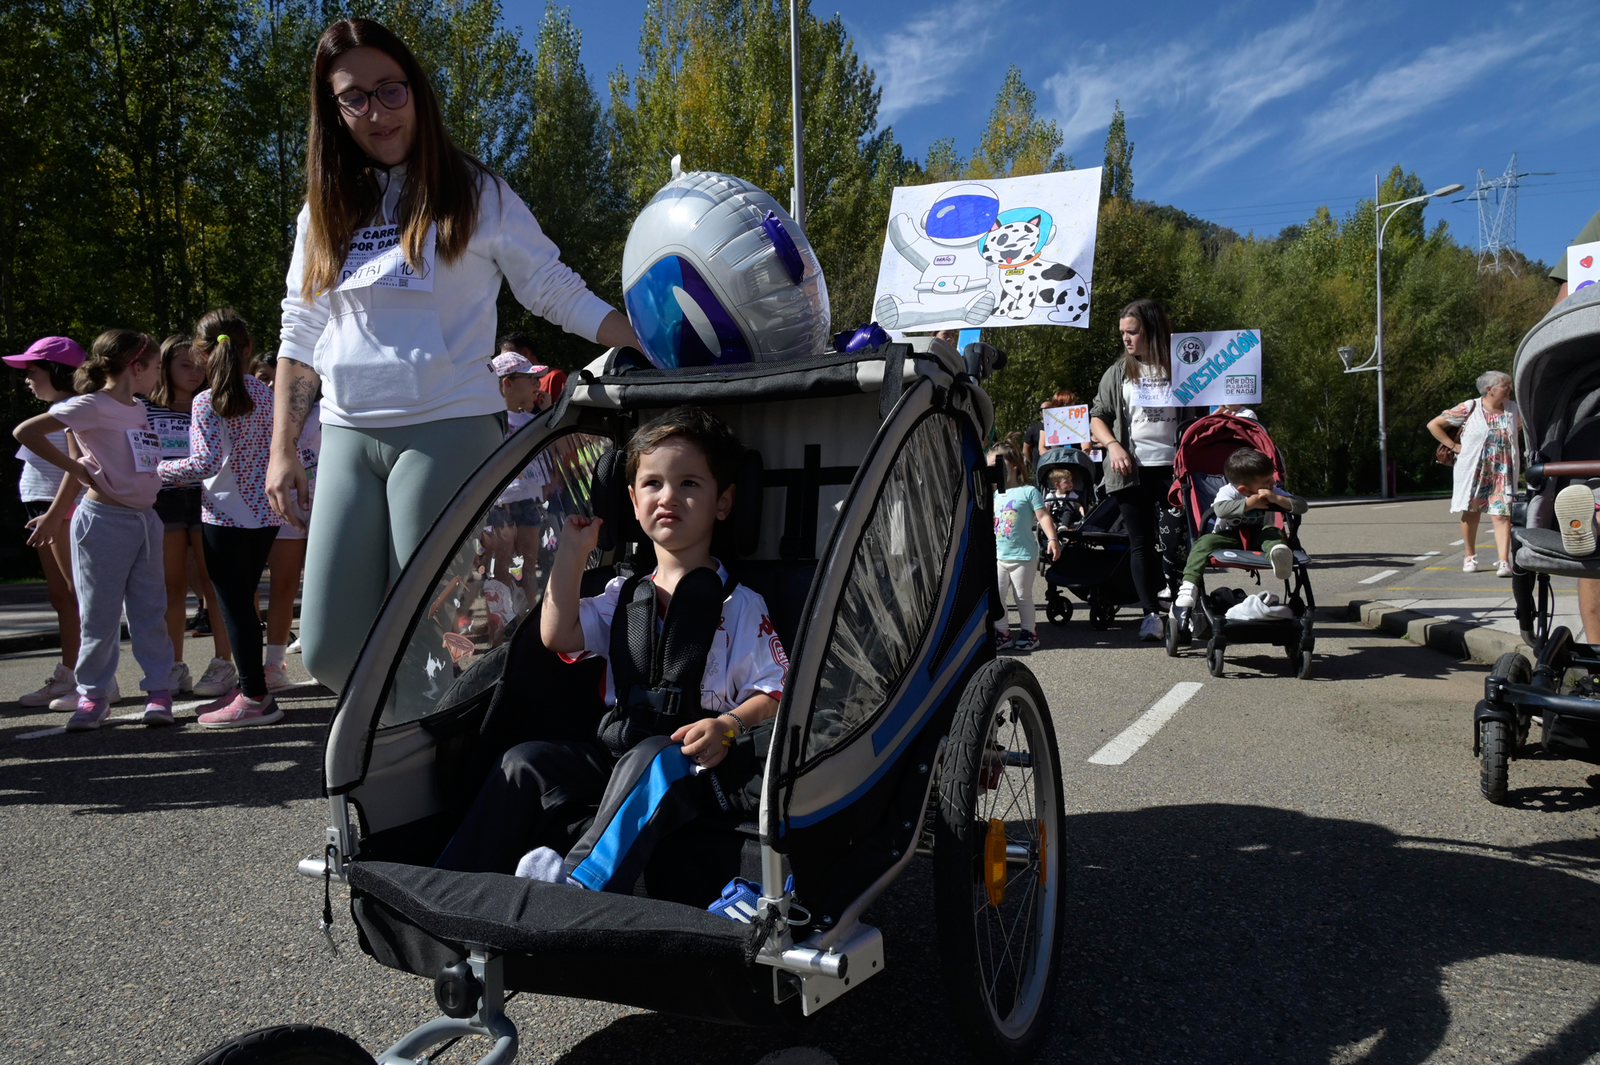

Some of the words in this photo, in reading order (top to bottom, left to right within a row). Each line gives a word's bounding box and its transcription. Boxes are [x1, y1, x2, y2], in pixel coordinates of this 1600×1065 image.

[363, 228, 402, 239] CARRE
[350, 242, 374, 251] POR
[378, 238, 400, 249] DAR
[1173, 329, 1260, 406] INVESTIGACIÓN
[1069, 407, 1087, 420] FOP
[1133, 416, 1177, 424] HANDLER
